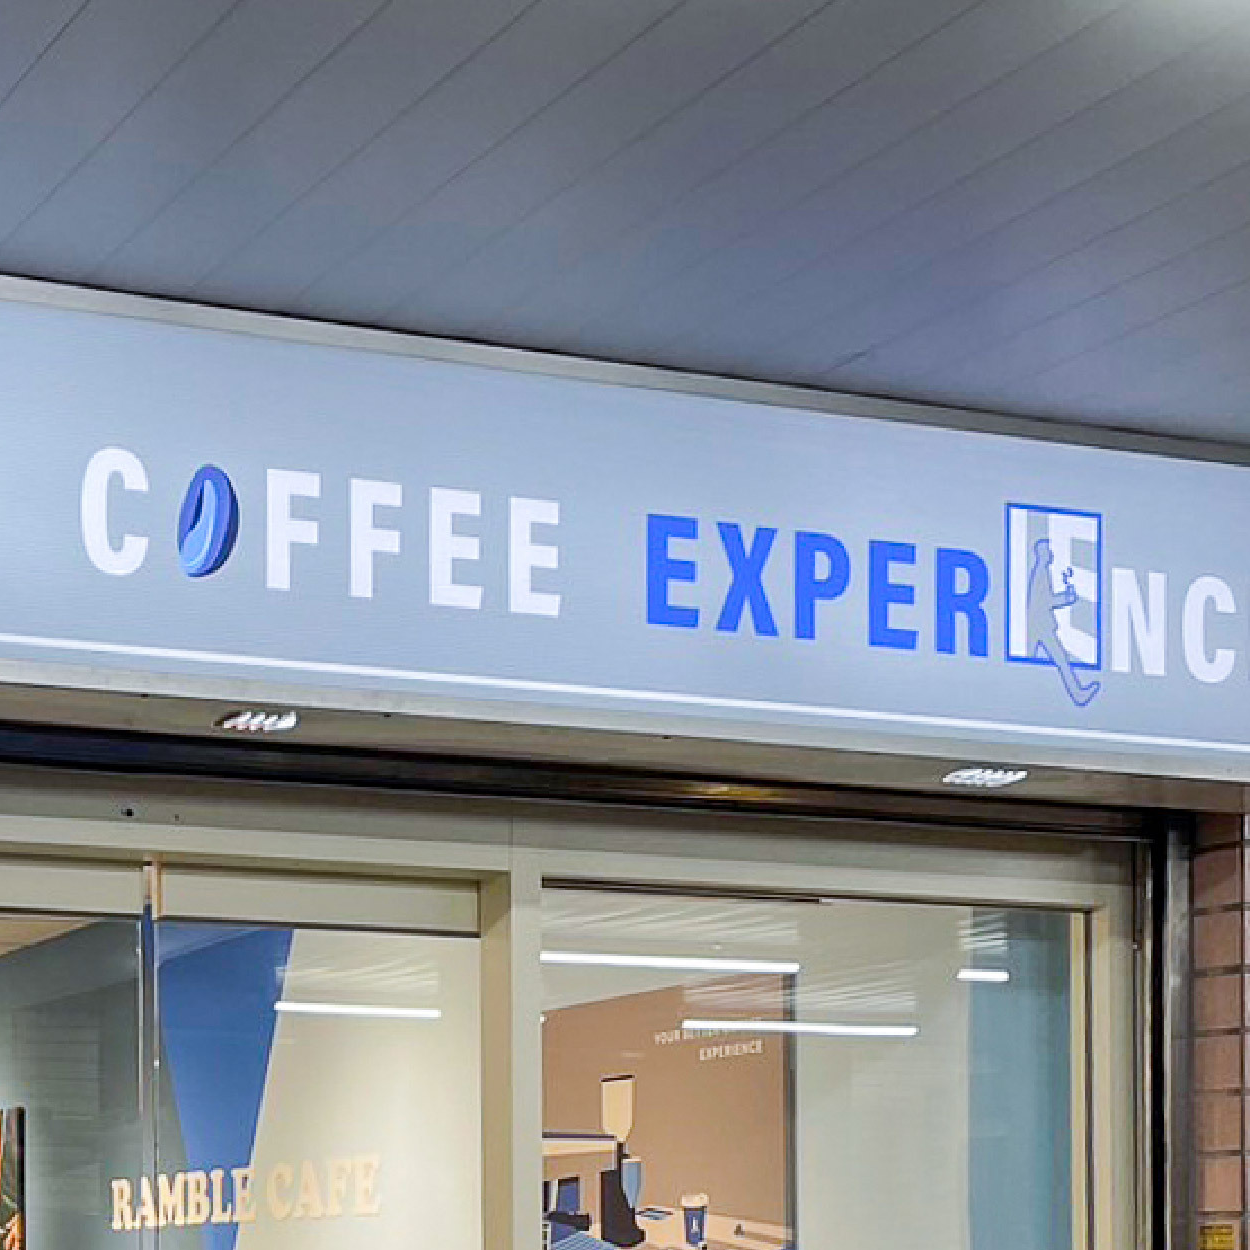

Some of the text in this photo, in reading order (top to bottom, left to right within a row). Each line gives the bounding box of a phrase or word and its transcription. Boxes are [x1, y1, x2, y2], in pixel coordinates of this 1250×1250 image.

[80, 445, 561, 618] COFFEE
[111, 1152, 382, 1230] RAMBLE CAFE
